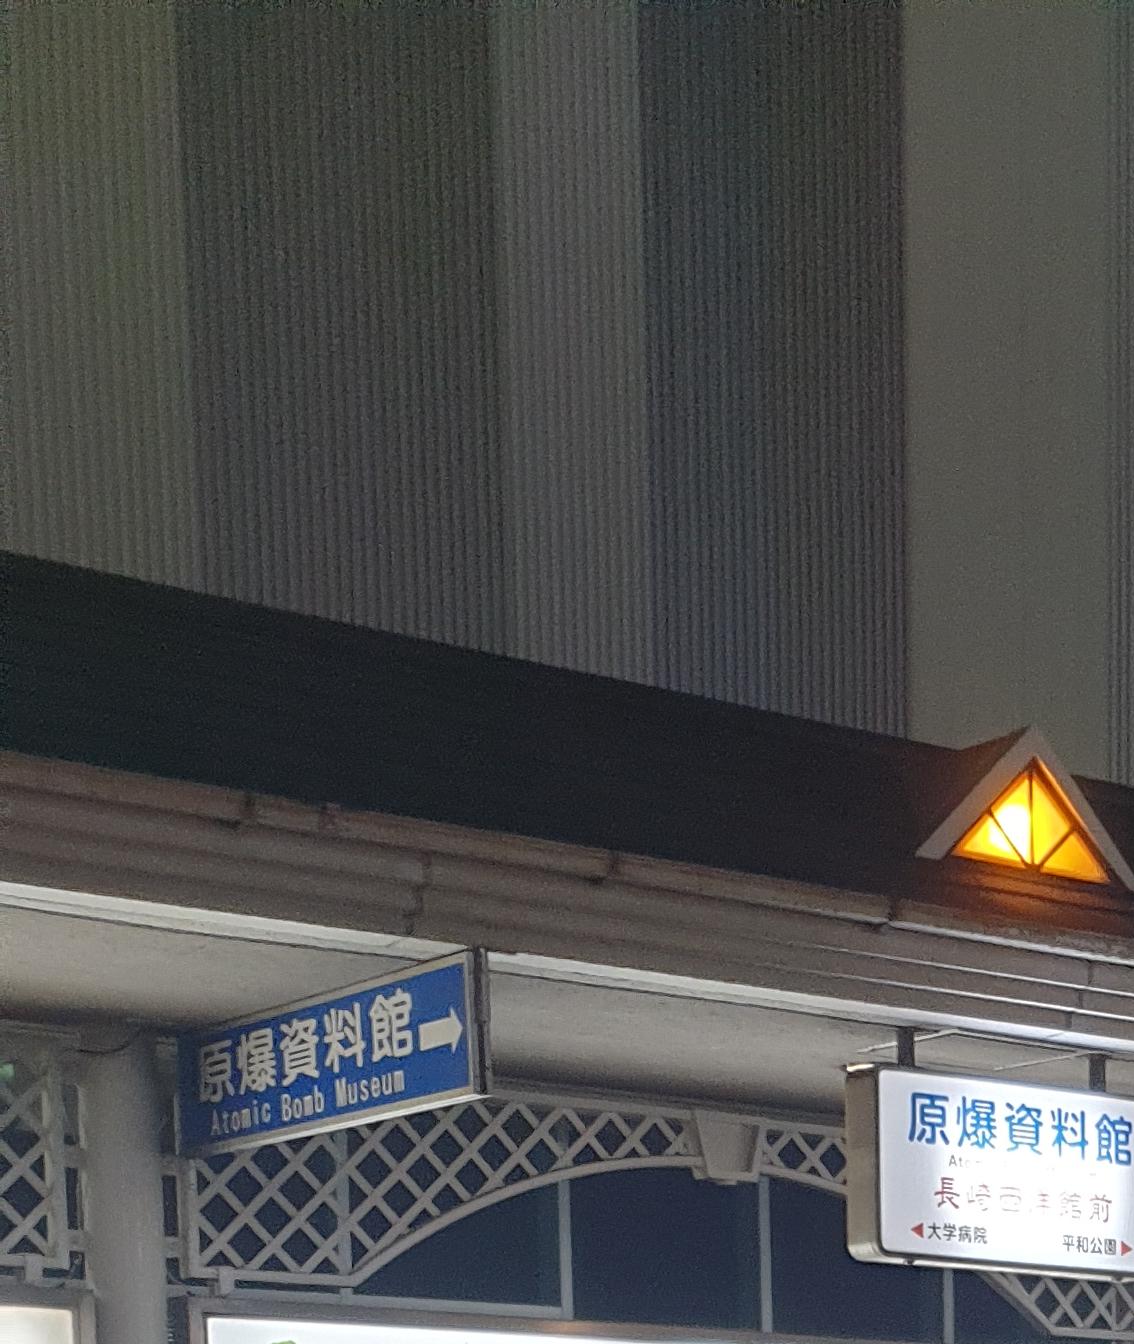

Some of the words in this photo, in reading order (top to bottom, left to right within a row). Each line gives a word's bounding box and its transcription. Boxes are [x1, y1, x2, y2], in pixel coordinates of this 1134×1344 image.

[200, 987, 414, 1104] 原爆資料館
[211, 1100, 271, 1136] Atomic
[281, 1085, 325, 1122] Bomb
[335, 1070, 406, 1108] Museum
[908, 1092, 1133, 1166] 原爆資料館
[927, 1222, 988, 1245] 大学病院
[1062, 1234, 1117, 1256] 平和公園
